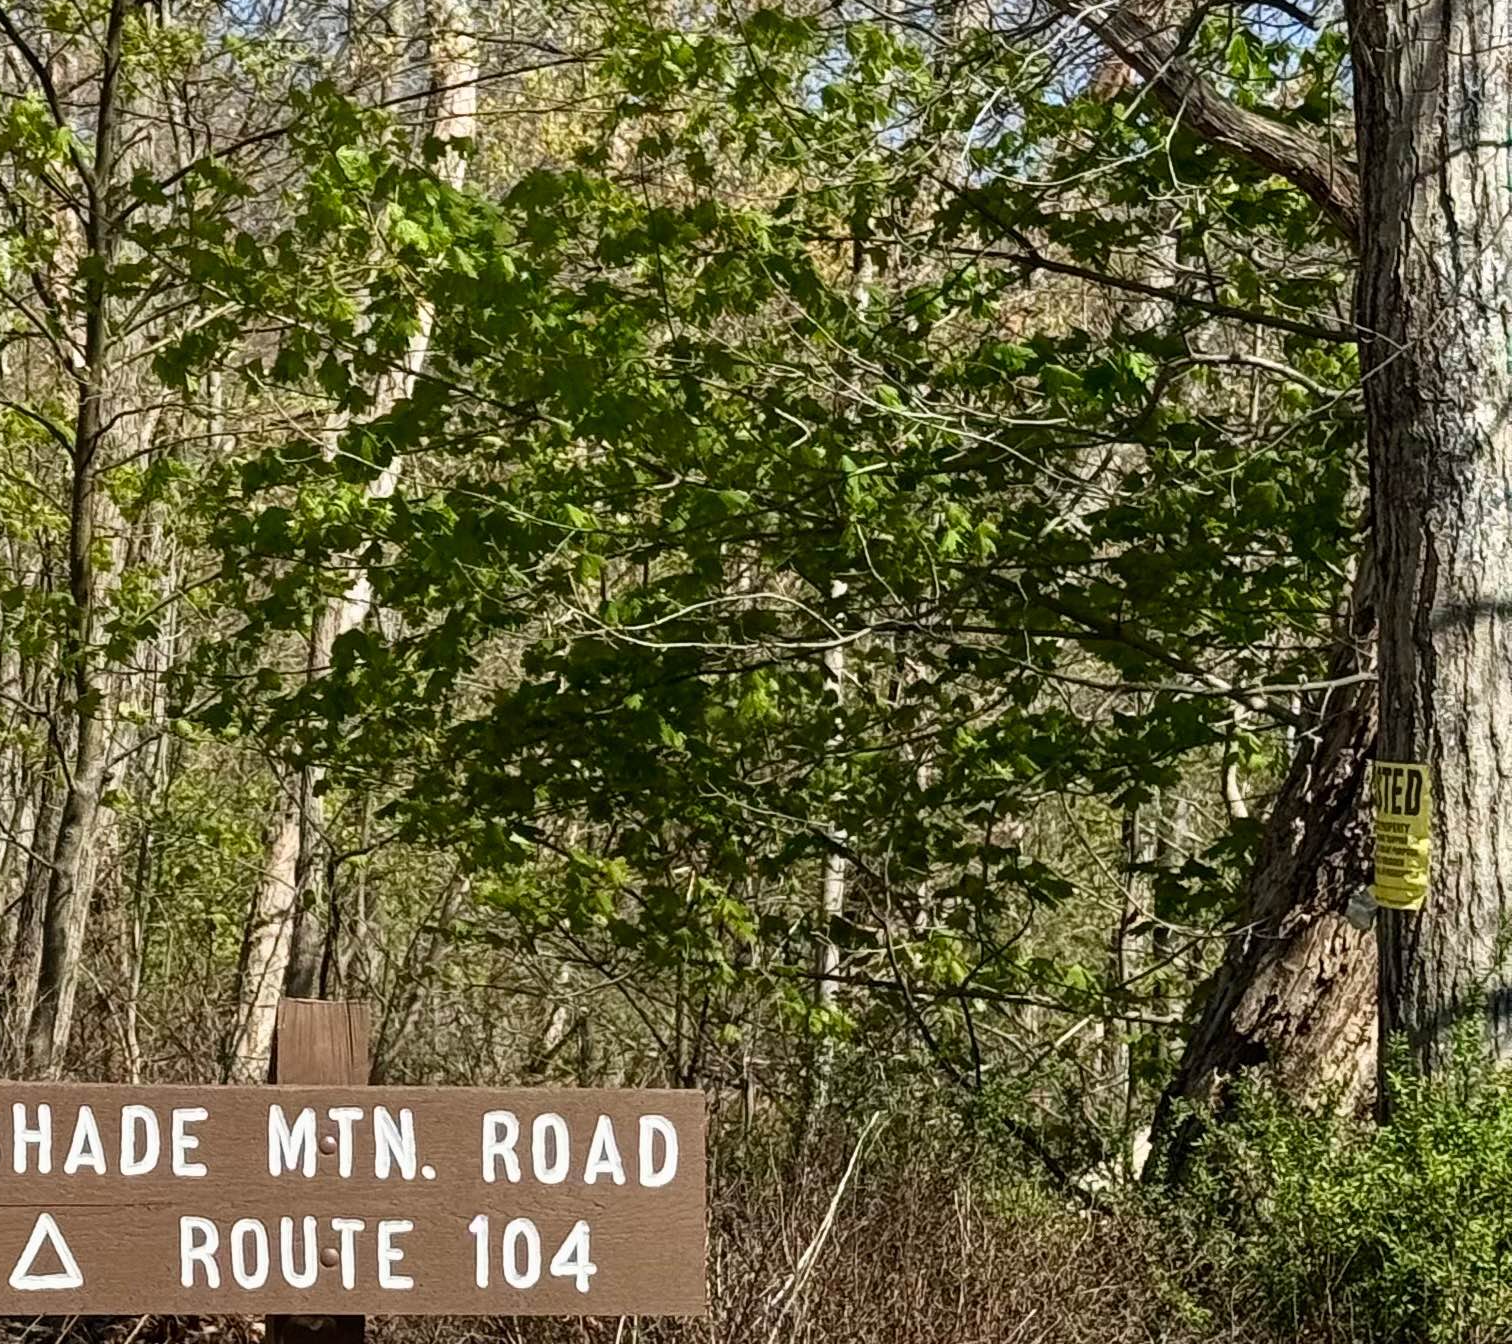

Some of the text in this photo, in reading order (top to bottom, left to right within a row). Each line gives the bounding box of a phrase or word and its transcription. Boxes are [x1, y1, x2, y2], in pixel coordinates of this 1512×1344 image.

[267, 1103, 437, 1181] MTN.
[481, 1110, 680, 1188] ROAD
[179, 1214, 598, 1294] ROUTE 104
